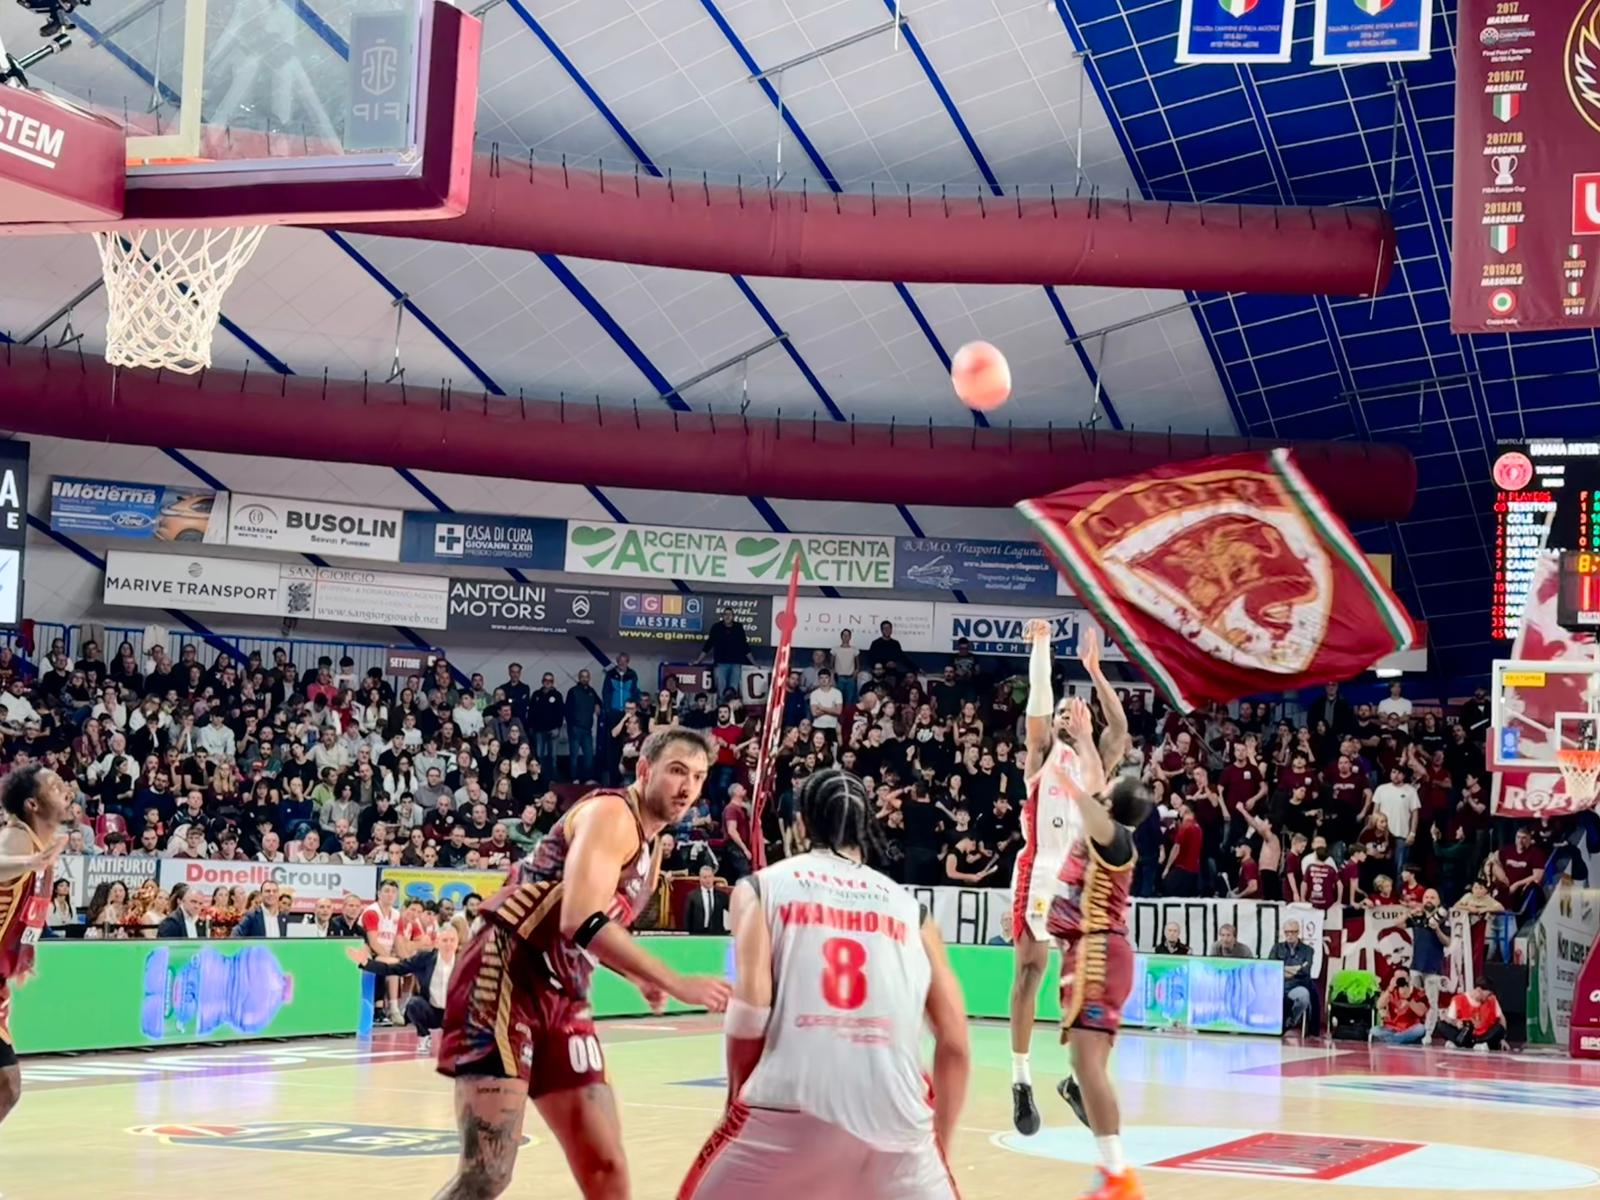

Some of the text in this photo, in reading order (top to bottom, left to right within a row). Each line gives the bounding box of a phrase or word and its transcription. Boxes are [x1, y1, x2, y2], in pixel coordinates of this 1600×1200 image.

[1496, 1, 1519, 14] 2017
[1486, 14, 1530, 25] MASCHILE
[1484, 82, 1528, 94] MASCHILE
[1483, 145, 1527, 155] MASCHILE
[1482, 214, 1525, 225] MASCHILE
[1481, 276, 1524, 287] MASCHILE
[1530, 443, 1567, 456] UMANA
[61, 482, 156, 505] Moderna
[1508, 491, 1552, 501] PLAYERS
[286, 510, 397, 538] BUSOLIN
[1506, 513, 1534, 524] COLE
[465, 525, 533, 543] CASA DI CURA
[465, 540, 533, 551] GIOVANNI XXIII
[611, 529, 728, 560] ARGENTA
[776, 539, 890, 566] ARGENTA
[954, 542, 1001, 557] Trasporti
[1004, 544, 1049, 559] Laguna
[611, 545, 728, 577] ACTIVE
[776, 553, 890, 582] ACTIVE
[1506, 560, 1537, 570] CAND
[288, 567, 375, 584] SAN GIORGIO
[106, 577, 277, 601] MARIVE TRANSPORT
[451, 583, 546, 602] ANTOLINI
[450, 600, 546, 620] MOTORS
[805, 612, 879, 625] JOINT
[635, 616, 687, 628] MESTRE
[733, 615, 753, 623] tuo
[953, 617, 1070, 638] NOVAX
[702, 670, 712, 689] 6
[88, 857, 156, 873] ANTIFURTO
[186, 863, 342, 890] DonelliGroup
[821, 936, 867, 1010] 8
[568, 1034, 603, 1073] 00
